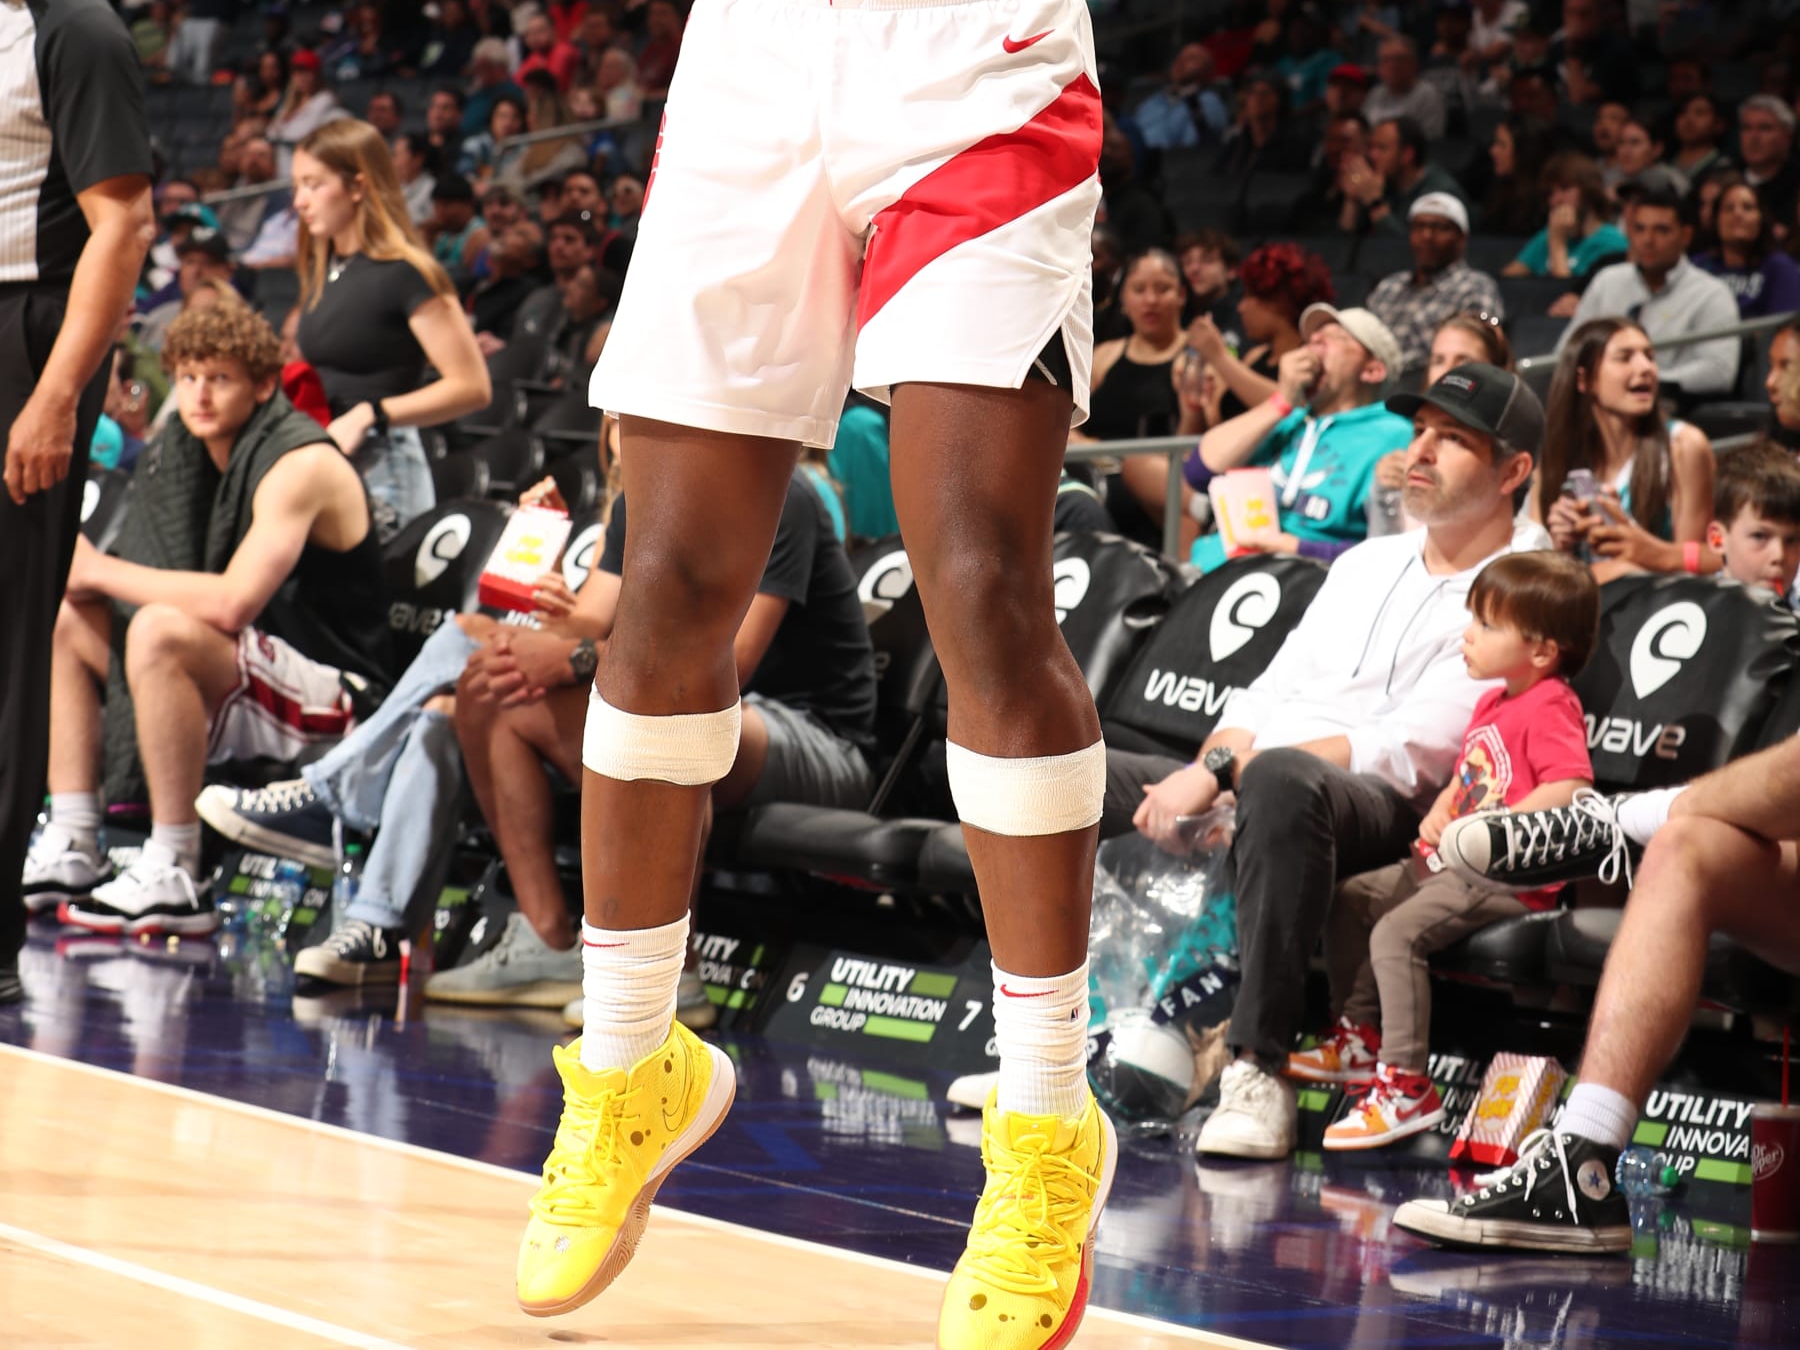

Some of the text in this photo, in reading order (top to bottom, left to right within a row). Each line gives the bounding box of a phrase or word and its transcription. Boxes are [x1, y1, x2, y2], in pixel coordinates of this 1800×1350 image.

[388, 602, 443, 635] ave
[1144, 668, 1234, 716] wav
[786, 972, 809, 1002] 6
[831, 957, 916, 993] UTILITY
[843, 988, 947, 1022] INNOVATION
[1159, 971, 1224, 1018] FAN
[810, 1006, 867, 1032] GROUP
[958, 1000, 983, 1031] 7
[1427, 1053, 1481, 1085] UTIL
[1645, 1090, 1754, 1129] UTILITY
[1665, 1125, 1750, 1158] INNOVA
[1653, 1153, 1696, 1176] OUP
[1751, 1150, 1780, 1176] pper
